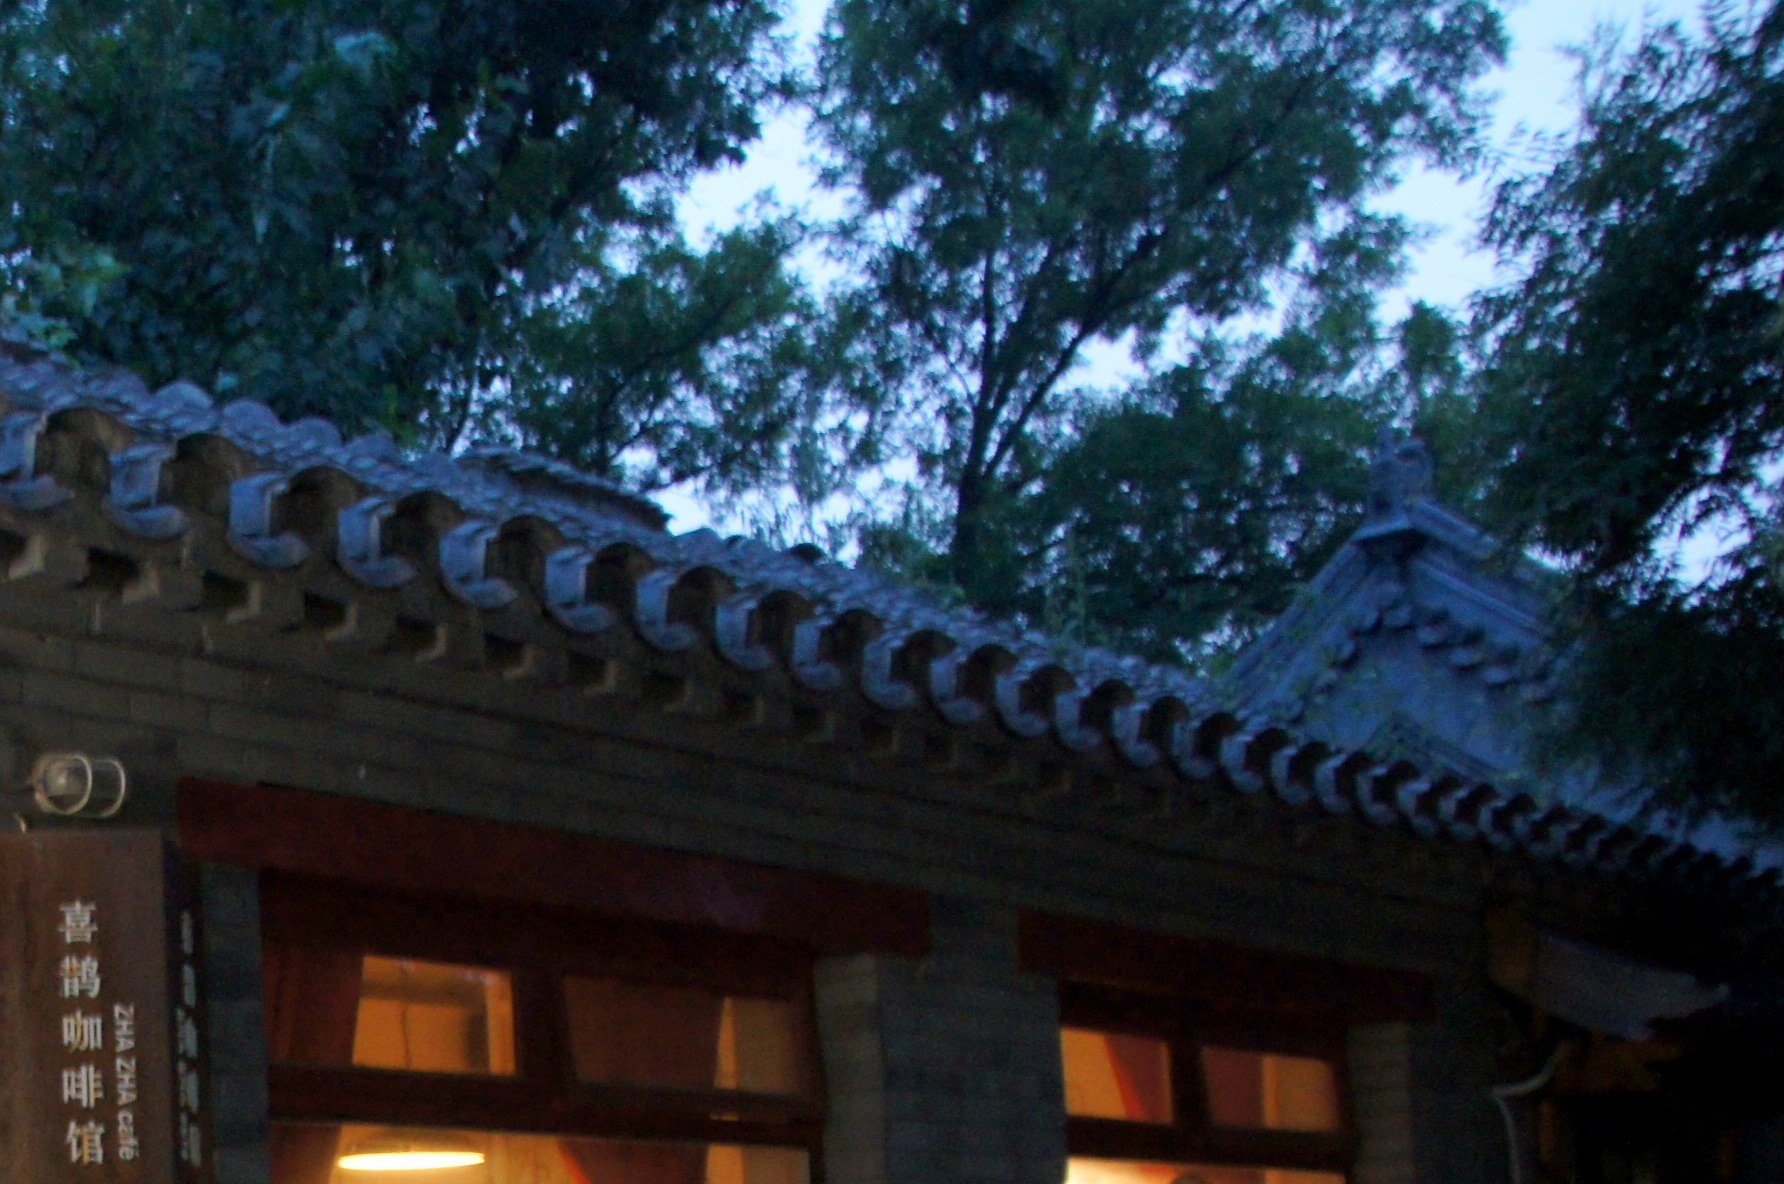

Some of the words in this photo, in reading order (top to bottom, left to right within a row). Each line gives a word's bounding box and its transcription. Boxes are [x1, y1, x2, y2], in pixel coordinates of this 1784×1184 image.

[59, 899, 105, 1165] 喜鹊咖啡馆
[114, 1001, 136, 1053] ZHA
[115, 1055, 138, 1106] ZHA
